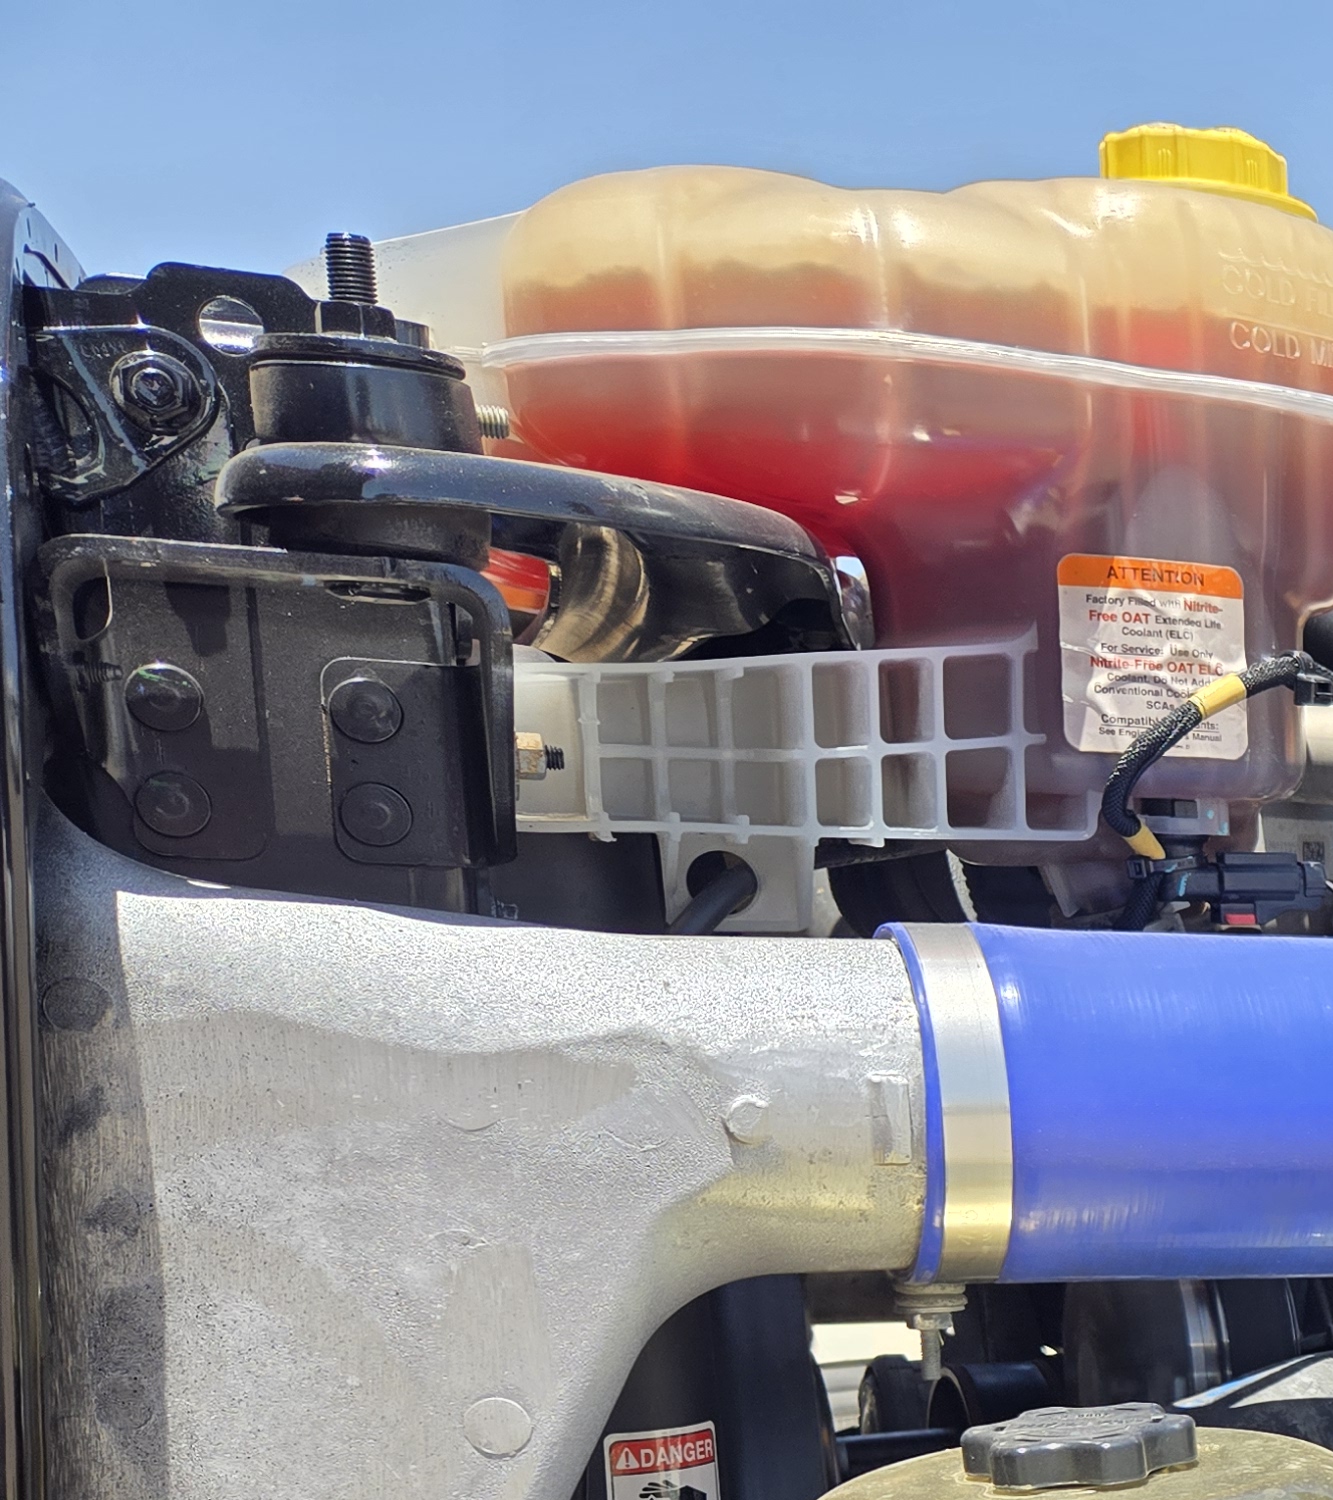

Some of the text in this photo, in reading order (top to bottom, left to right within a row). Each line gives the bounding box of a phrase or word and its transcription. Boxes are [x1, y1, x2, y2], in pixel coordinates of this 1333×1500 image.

[1230, 321, 1300, 359] COLD
[1106, 565, 1206, 587] ATTENTION
[1085, 593, 1125, 608] Factory
[1183, 597, 1224, 615] Nitrite-
[1088, 609, 1118, 622] Free
[1122, 610, 1152, 625] OAT
[1154, 614, 1202, 629] Extended
[1121, 626, 1194, 642] Coolant (ELC)
[1101, 642, 1118, 653] For
[1170, 644, 1190, 657] Use
[1166, 661, 1194, 675] OAT
[1199, 662, 1224, 677] ELC
[1153, 675, 1168, 685] Do
[1093, 684, 1164, 698] Conventional
[1098, 727, 1116, 737] See
[640, 1439, 714, 1468] DANGER
